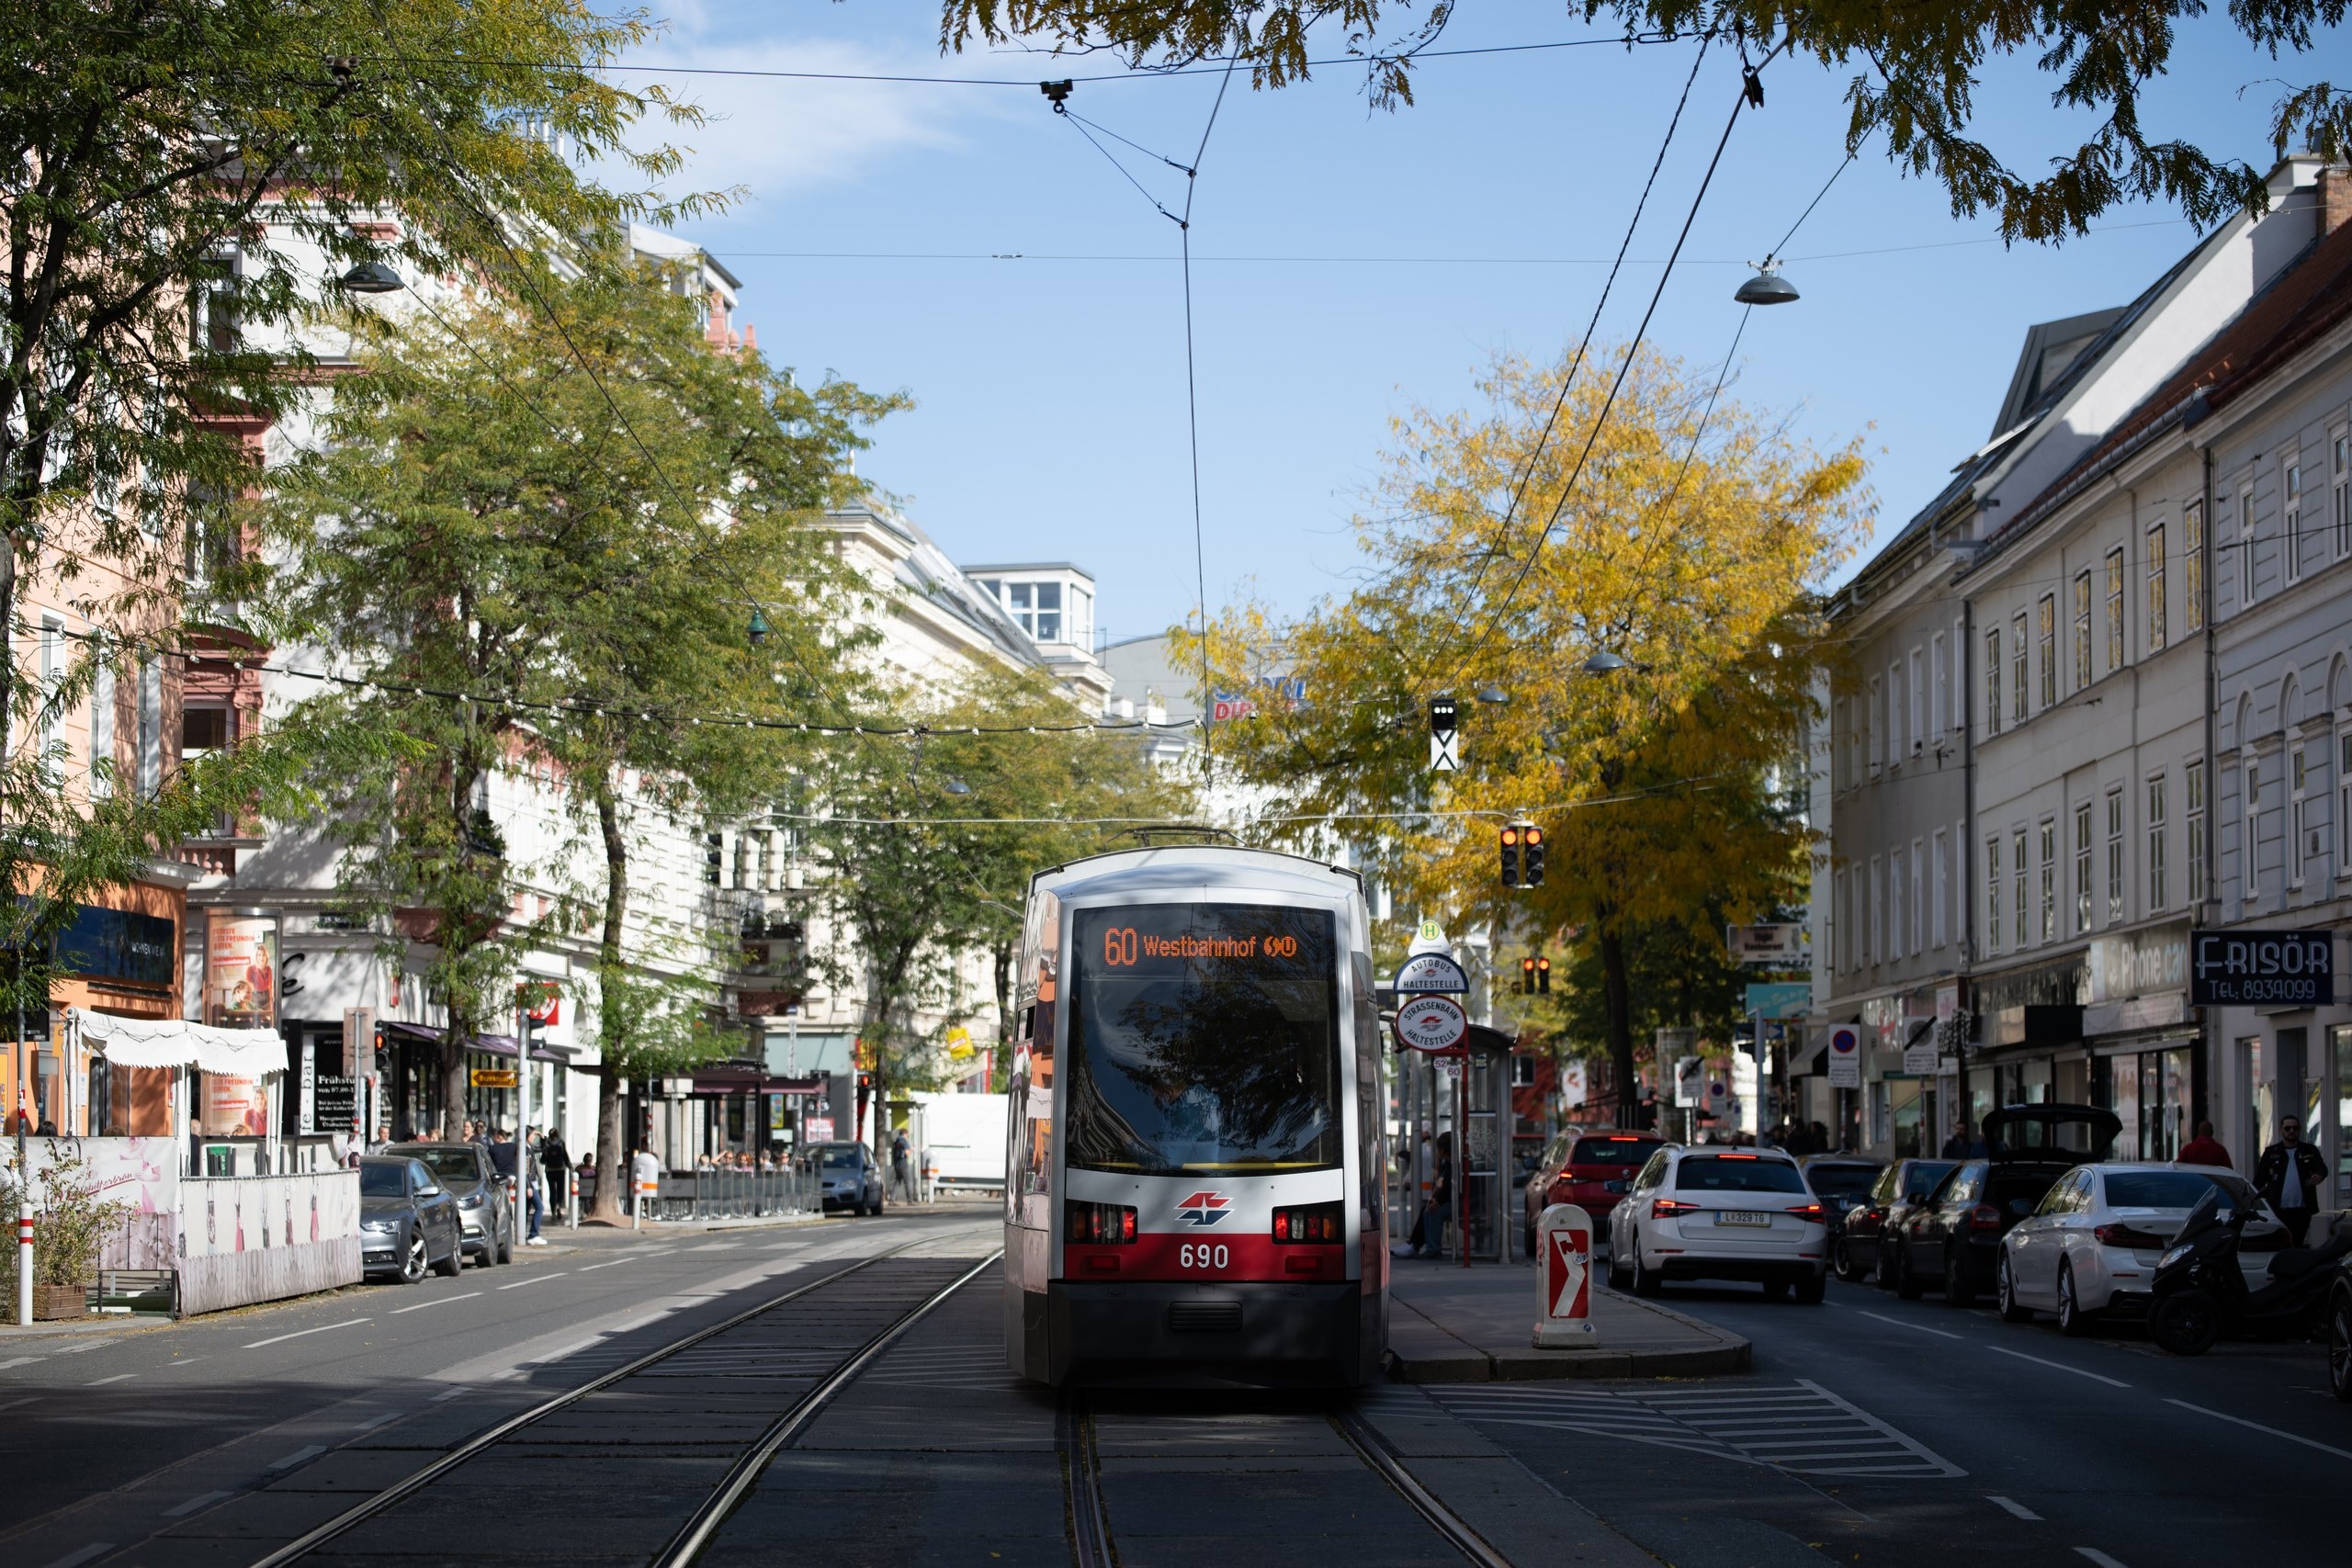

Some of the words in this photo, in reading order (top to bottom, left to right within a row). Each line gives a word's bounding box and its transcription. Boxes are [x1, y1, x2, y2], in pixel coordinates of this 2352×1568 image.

[1424, 925, 1435, 937] H
[1105, 928, 1137, 965] 60
[1143, 935, 1256, 957] Westbahnhof
[2196, 933, 2329, 979] FRISÖR
[1411, 959, 1452, 974] AUTOBUS
[2120, 942, 2160, 990] Phone
[2164, 942, 2188, 984] car
[1404, 980, 1458, 988] HALTESTELLE
[2243, 979, 2316, 999] 8934099
[1404, 1001, 1460, 1021] STRASSENBAHN
[1406, 1029, 1457, 1046] HALTESTELLE
[301, 1055, 312, 1089] bar
[1435, 1060, 1446, 1068] 52
[318, 1075, 355, 1084] Frühstü
[1736, 1213, 1752, 1223] 329
[1181, 1244, 1228, 1269] 690
